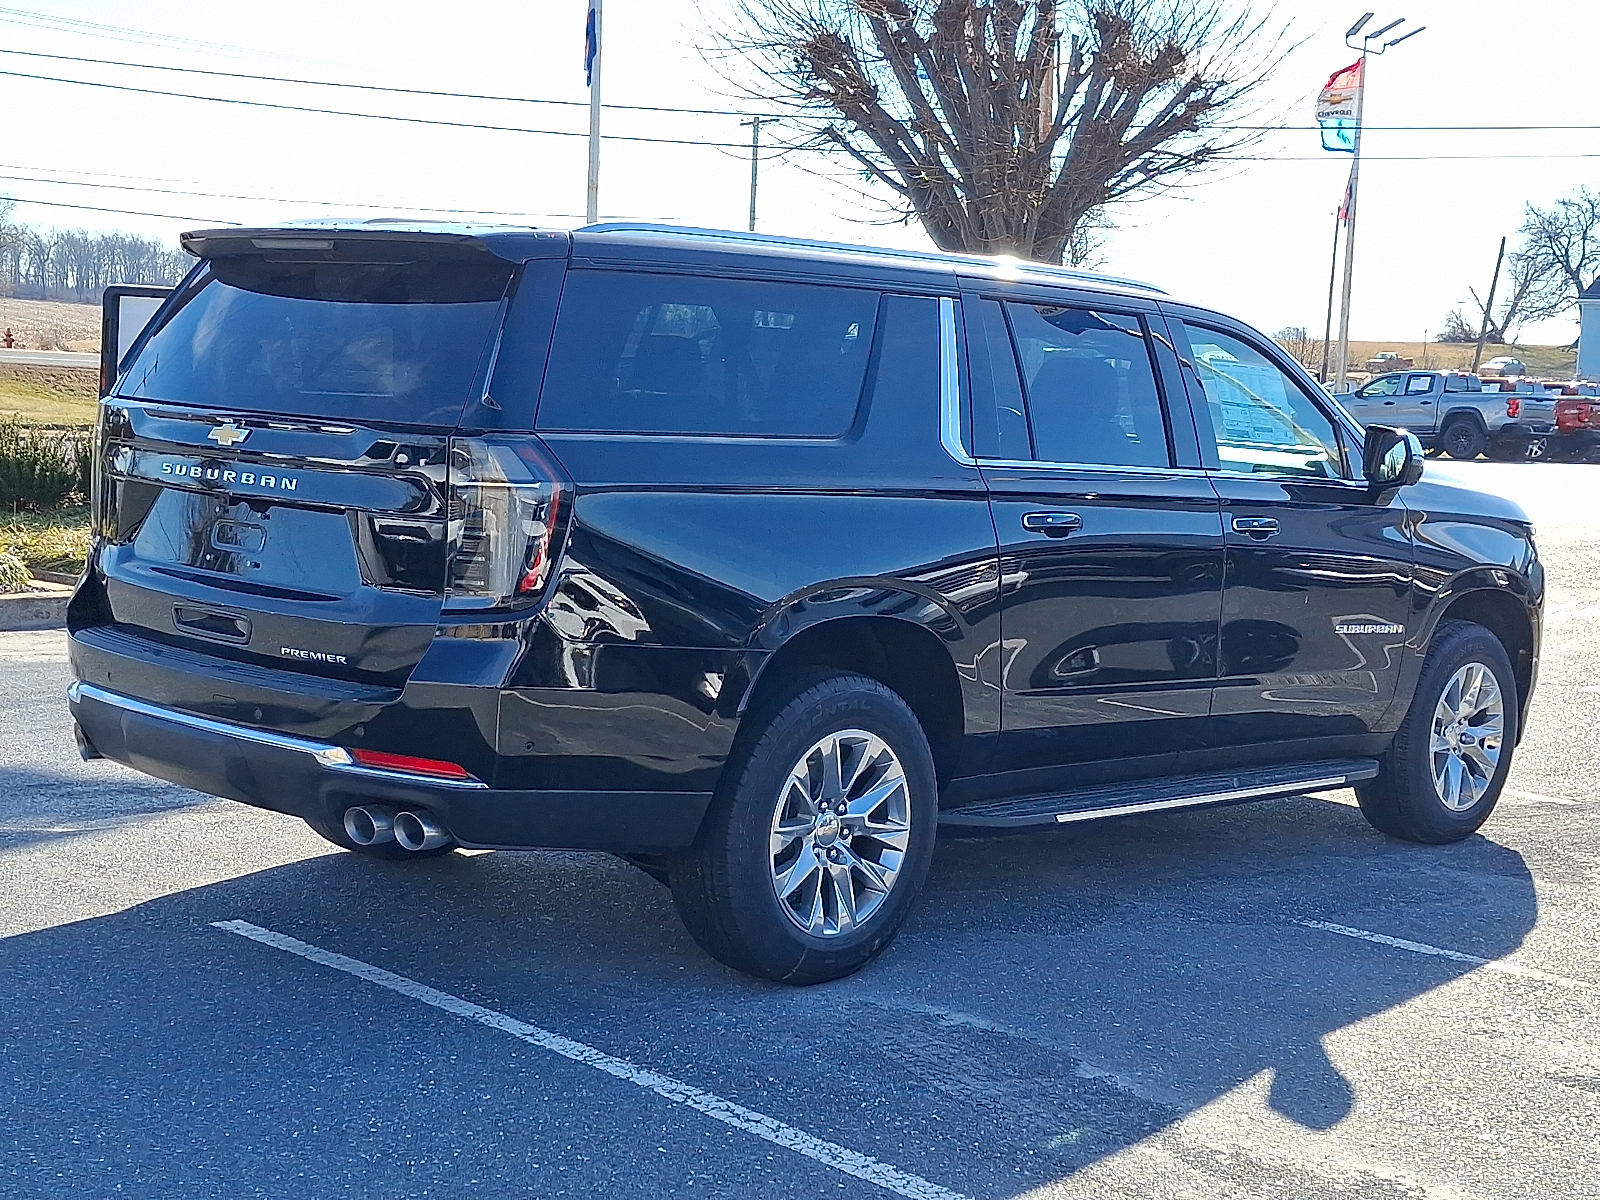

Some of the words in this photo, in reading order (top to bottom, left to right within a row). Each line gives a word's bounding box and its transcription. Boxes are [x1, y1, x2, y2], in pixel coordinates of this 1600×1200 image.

[160, 462, 298, 491] SUBURBAN
[1335, 624, 1403, 634] SUBURBAN
[281, 647, 347, 665] PREMIER
